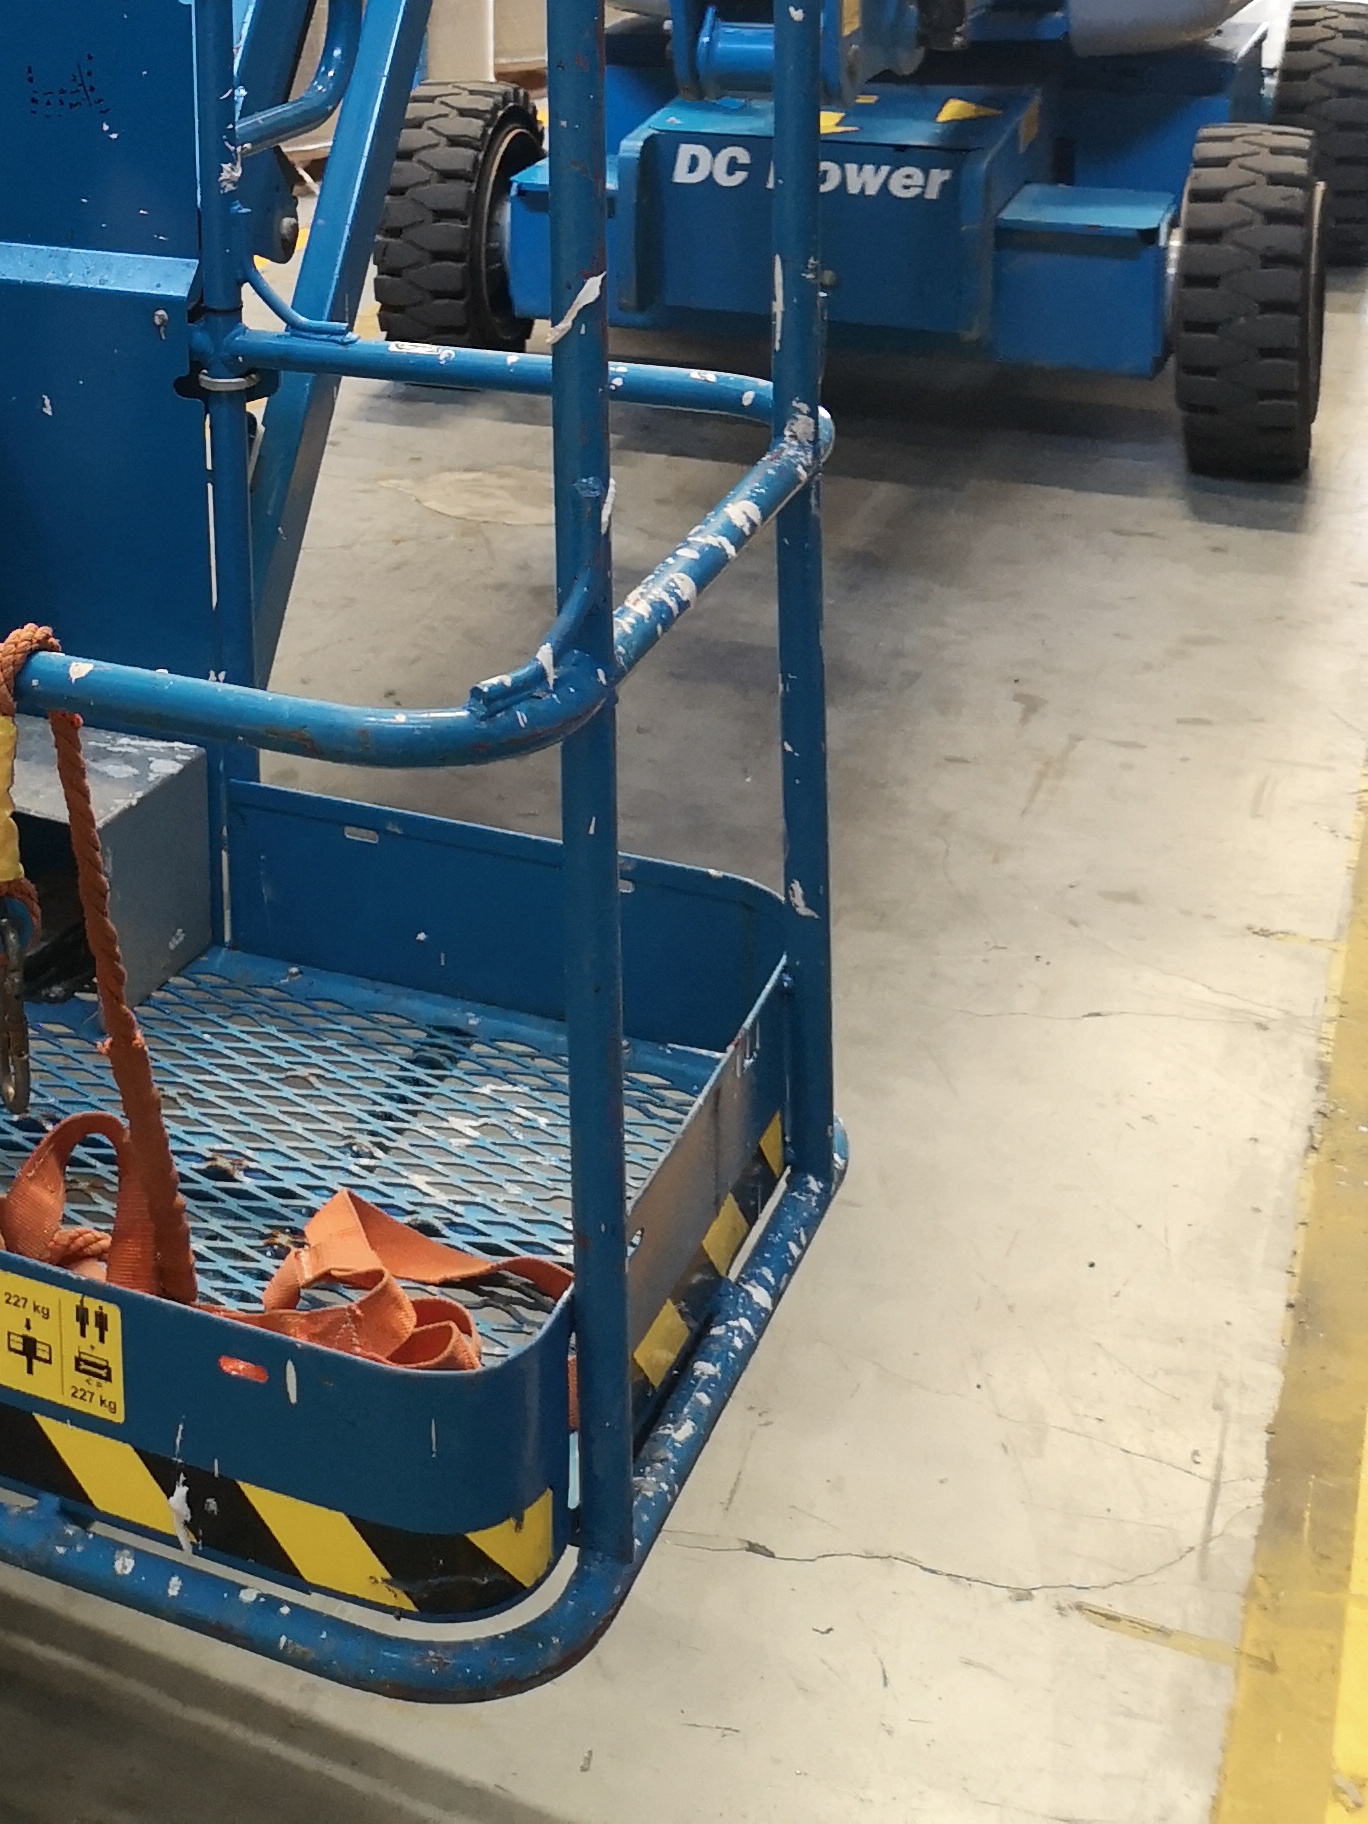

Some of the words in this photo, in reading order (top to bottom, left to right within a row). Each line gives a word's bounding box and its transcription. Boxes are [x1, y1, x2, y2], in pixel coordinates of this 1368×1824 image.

[672, 142, 752, 188] DC
[765, 156, 953, 201] ower
[3, 1291, 28, 1309] 227
[32, 1300, 51, 1320] kg
[70, 1385, 96, 1403] 227
[99, 1394, 118, 1414] kg
